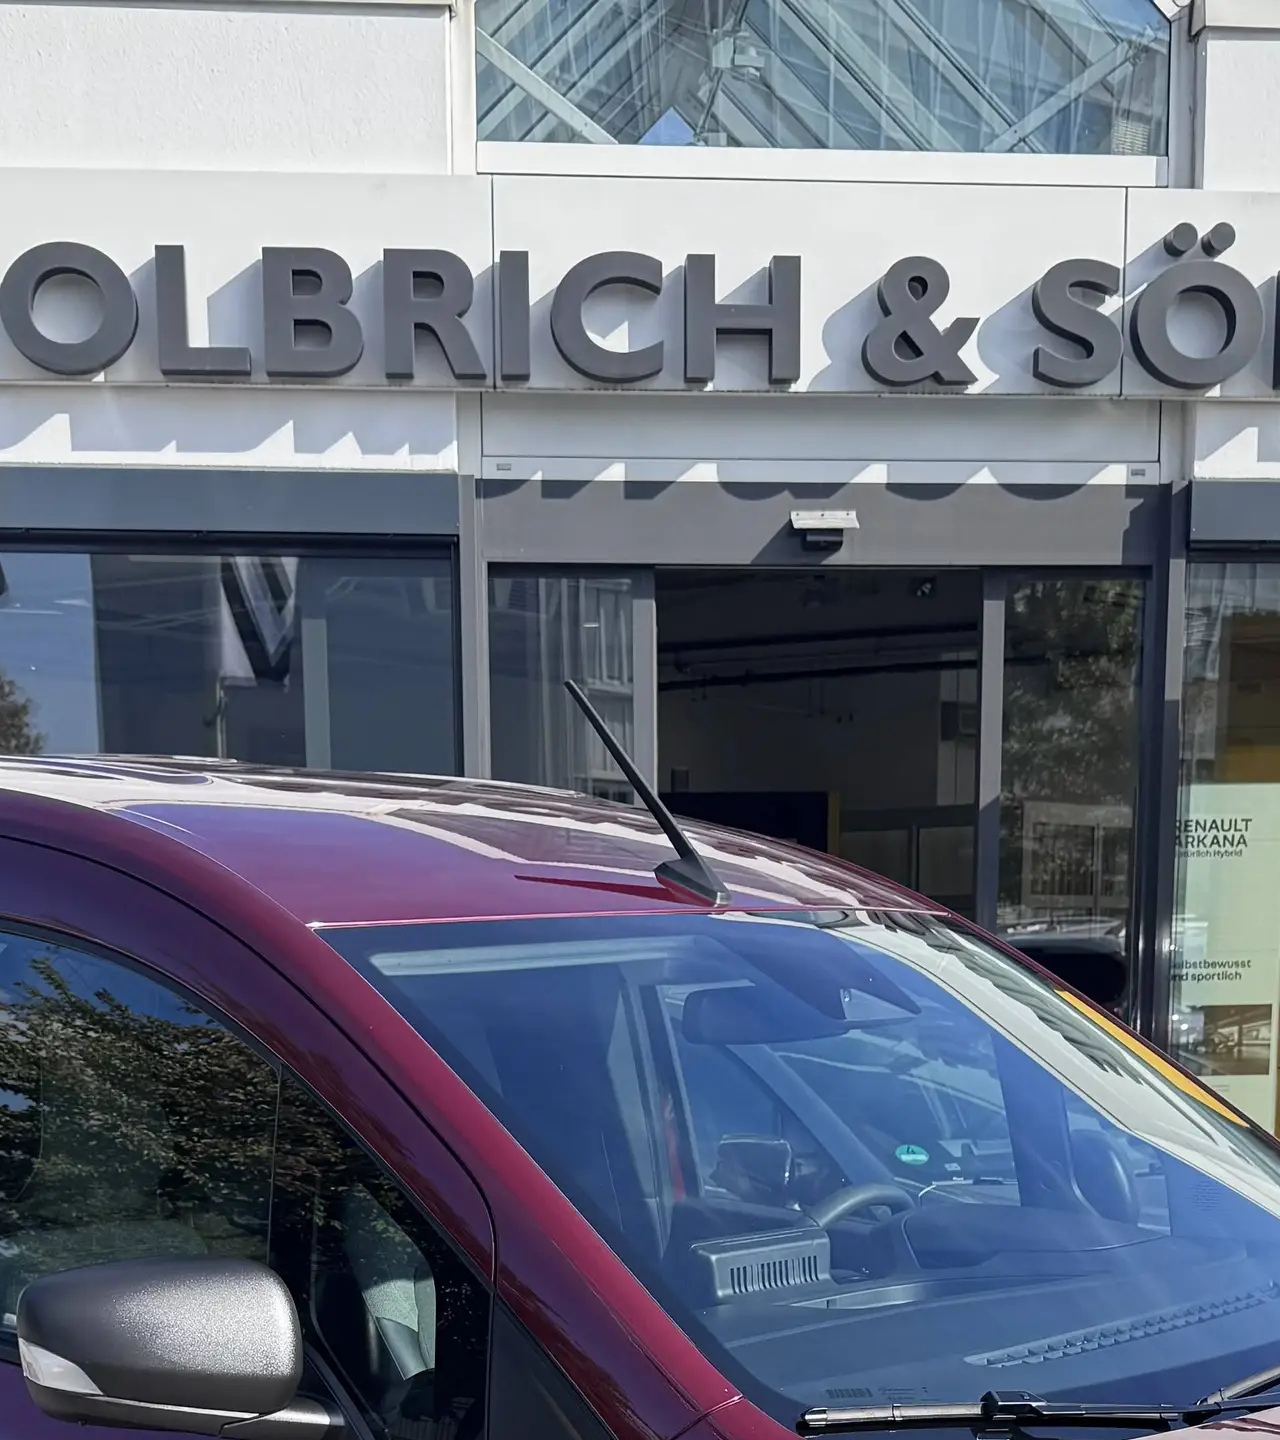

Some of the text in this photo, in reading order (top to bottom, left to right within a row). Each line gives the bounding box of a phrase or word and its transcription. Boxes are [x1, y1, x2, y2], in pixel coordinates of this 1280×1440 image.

[862, 256, 980, 387] &
[1175, 818, 1253, 833] RENAULT
[1174, 833, 1248, 849] ARKANA
[1191, 969, 1242, 983] sportlich
